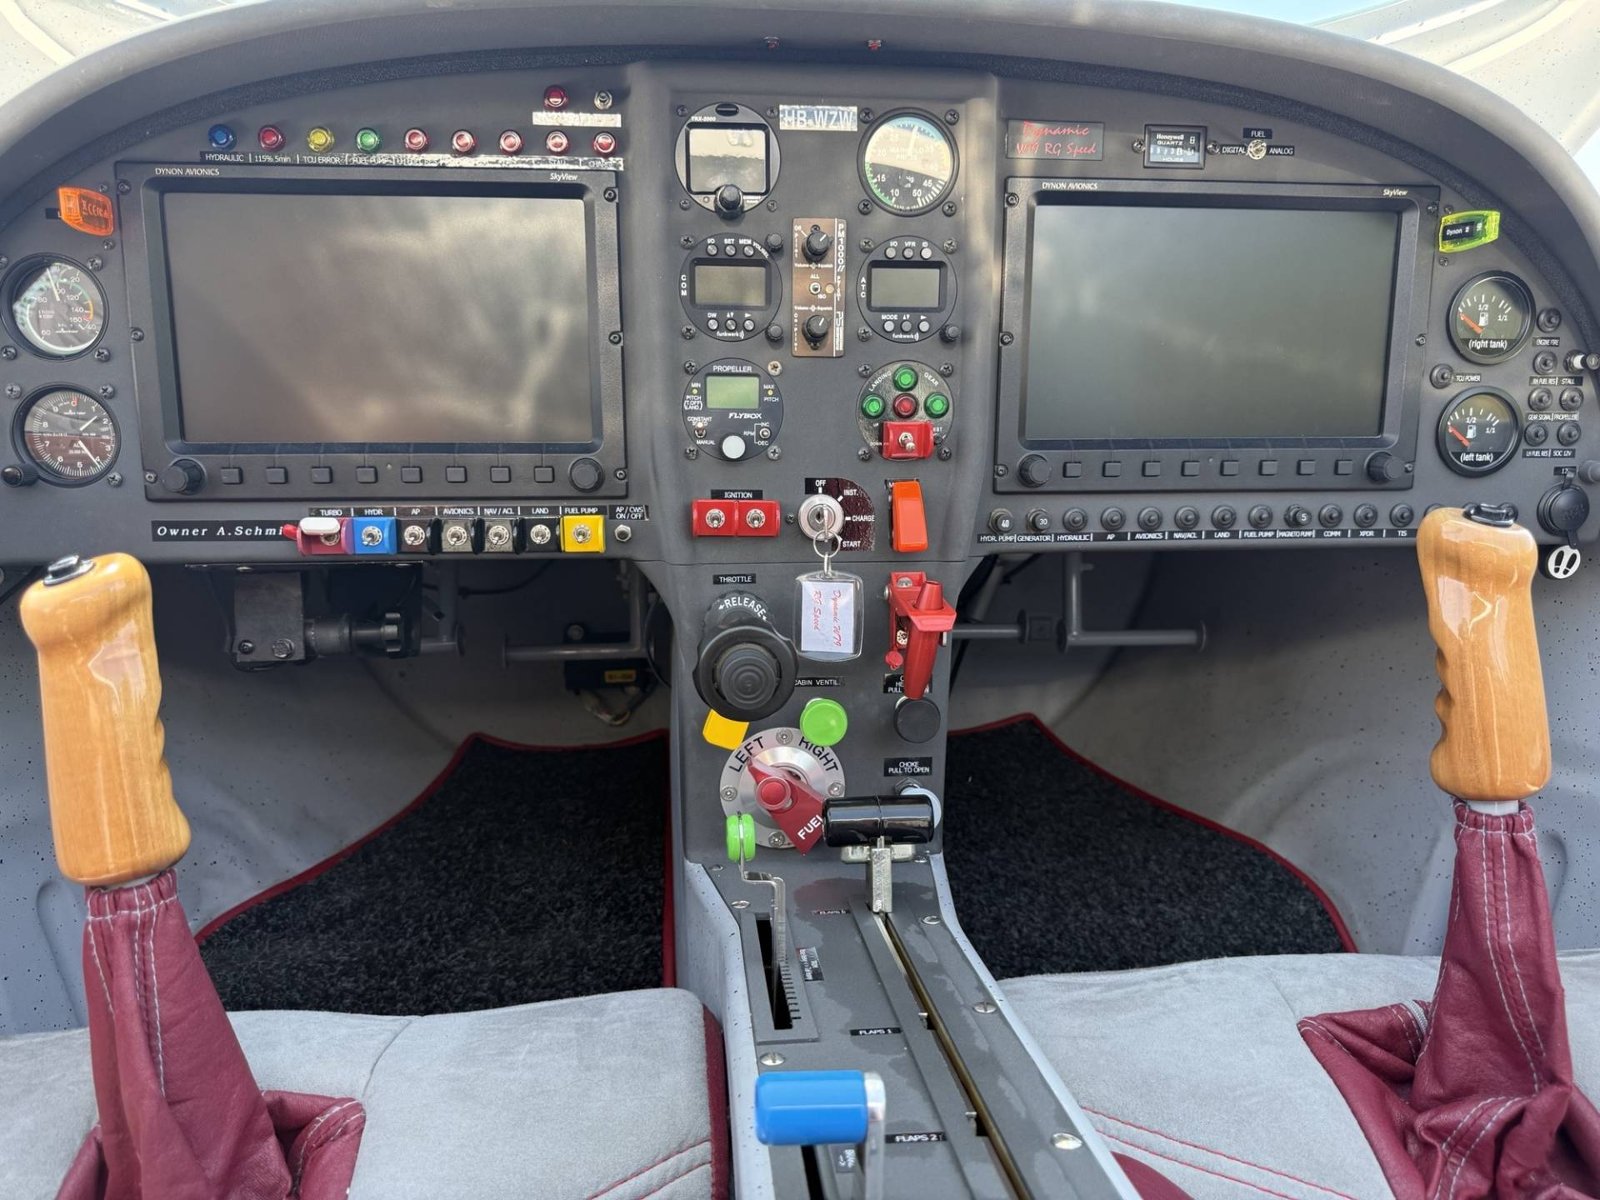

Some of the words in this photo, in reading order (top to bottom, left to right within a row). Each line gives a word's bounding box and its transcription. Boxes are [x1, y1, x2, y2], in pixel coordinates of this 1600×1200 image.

[1156, 133, 1184, 141] Honeywell
[1250, 130, 1266, 138] FUEL
[1044, 142, 1062, 156] RG
[1066, 141, 1096, 158] Speed
[1222, 146, 1247, 154] DIGITAL
[205, 153, 245, 162] HYDRAULIC
[274, 155, 292, 163] 5min
[317, 156, 341, 164] ERROR
[155, 167, 184, 175] DYNON
[184, 167, 220, 176] AVIONICS
[549, 172, 578, 182] SkyView
[1041, 182, 1067, 190] DYNON
[1067, 182, 1098, 190] AVIONICS
[889, 188, 900, 197] 10
[1382, 188, 1408, 197] SkyView
[1468, 339, 1489, 350] (right
[1489, 339, 1508, 350] tank)
[712, 365, 752, 373] PROPELLER
[868, 370, 892, 392] LANDING
[923, 371, 940, 387] GEAR
[728, 412, 763, 420] FLYBOX
[42, 421, 49, 429] 8
[102, 417, 109, 425] 2
[105, 444, 112, 452] 3
[57, 455, 64, 463] 6
[1460, 452, 1475, 462] (left
[1475, 452, 1494, 462] tank)
[815, 479, 826, 487] OFF
[724, 491, 753, 499] IGNITION
[843, 488, 860, 496] INST.
[320, 509, 343, 517] TURBO
[364, 509, 384, 517] HYDR
[411, 507, 421, 515] AP
[443, 507, 474, 515] AVIONICS
[484, 507, 498, 515] NAV
[502, 507, 515, 515] ACL
[531, 507, 549, 515] LAND
[564, 507, 580, 515] FUEL
[581, 507, 598, 515] PUMP
[1301, 513, 1307, 522] 5
[1001, 519, 1010, 528] 40
[157, 526, 208, 536] Owner
[216, 526, 284, 536] A.Schmi
[998, 534, 1015, 542] PUMP
[1017, 534, 1051, 542] GENERATOR
[842, 540, 861, 548] START
[719, 575, 752, 583] THROTTLE
[723, 596, 767, 618] RELEASE
[832, 590, 843, 622] Dynamic
[812, 606, 823, 632] Speed
[728, 736, 765, 773] LEFT
[798, 736, 839, 773] RIGHT
[895, 1133, 928, 1142] FLAPS
[930, 1133, 938, 1142] 2
